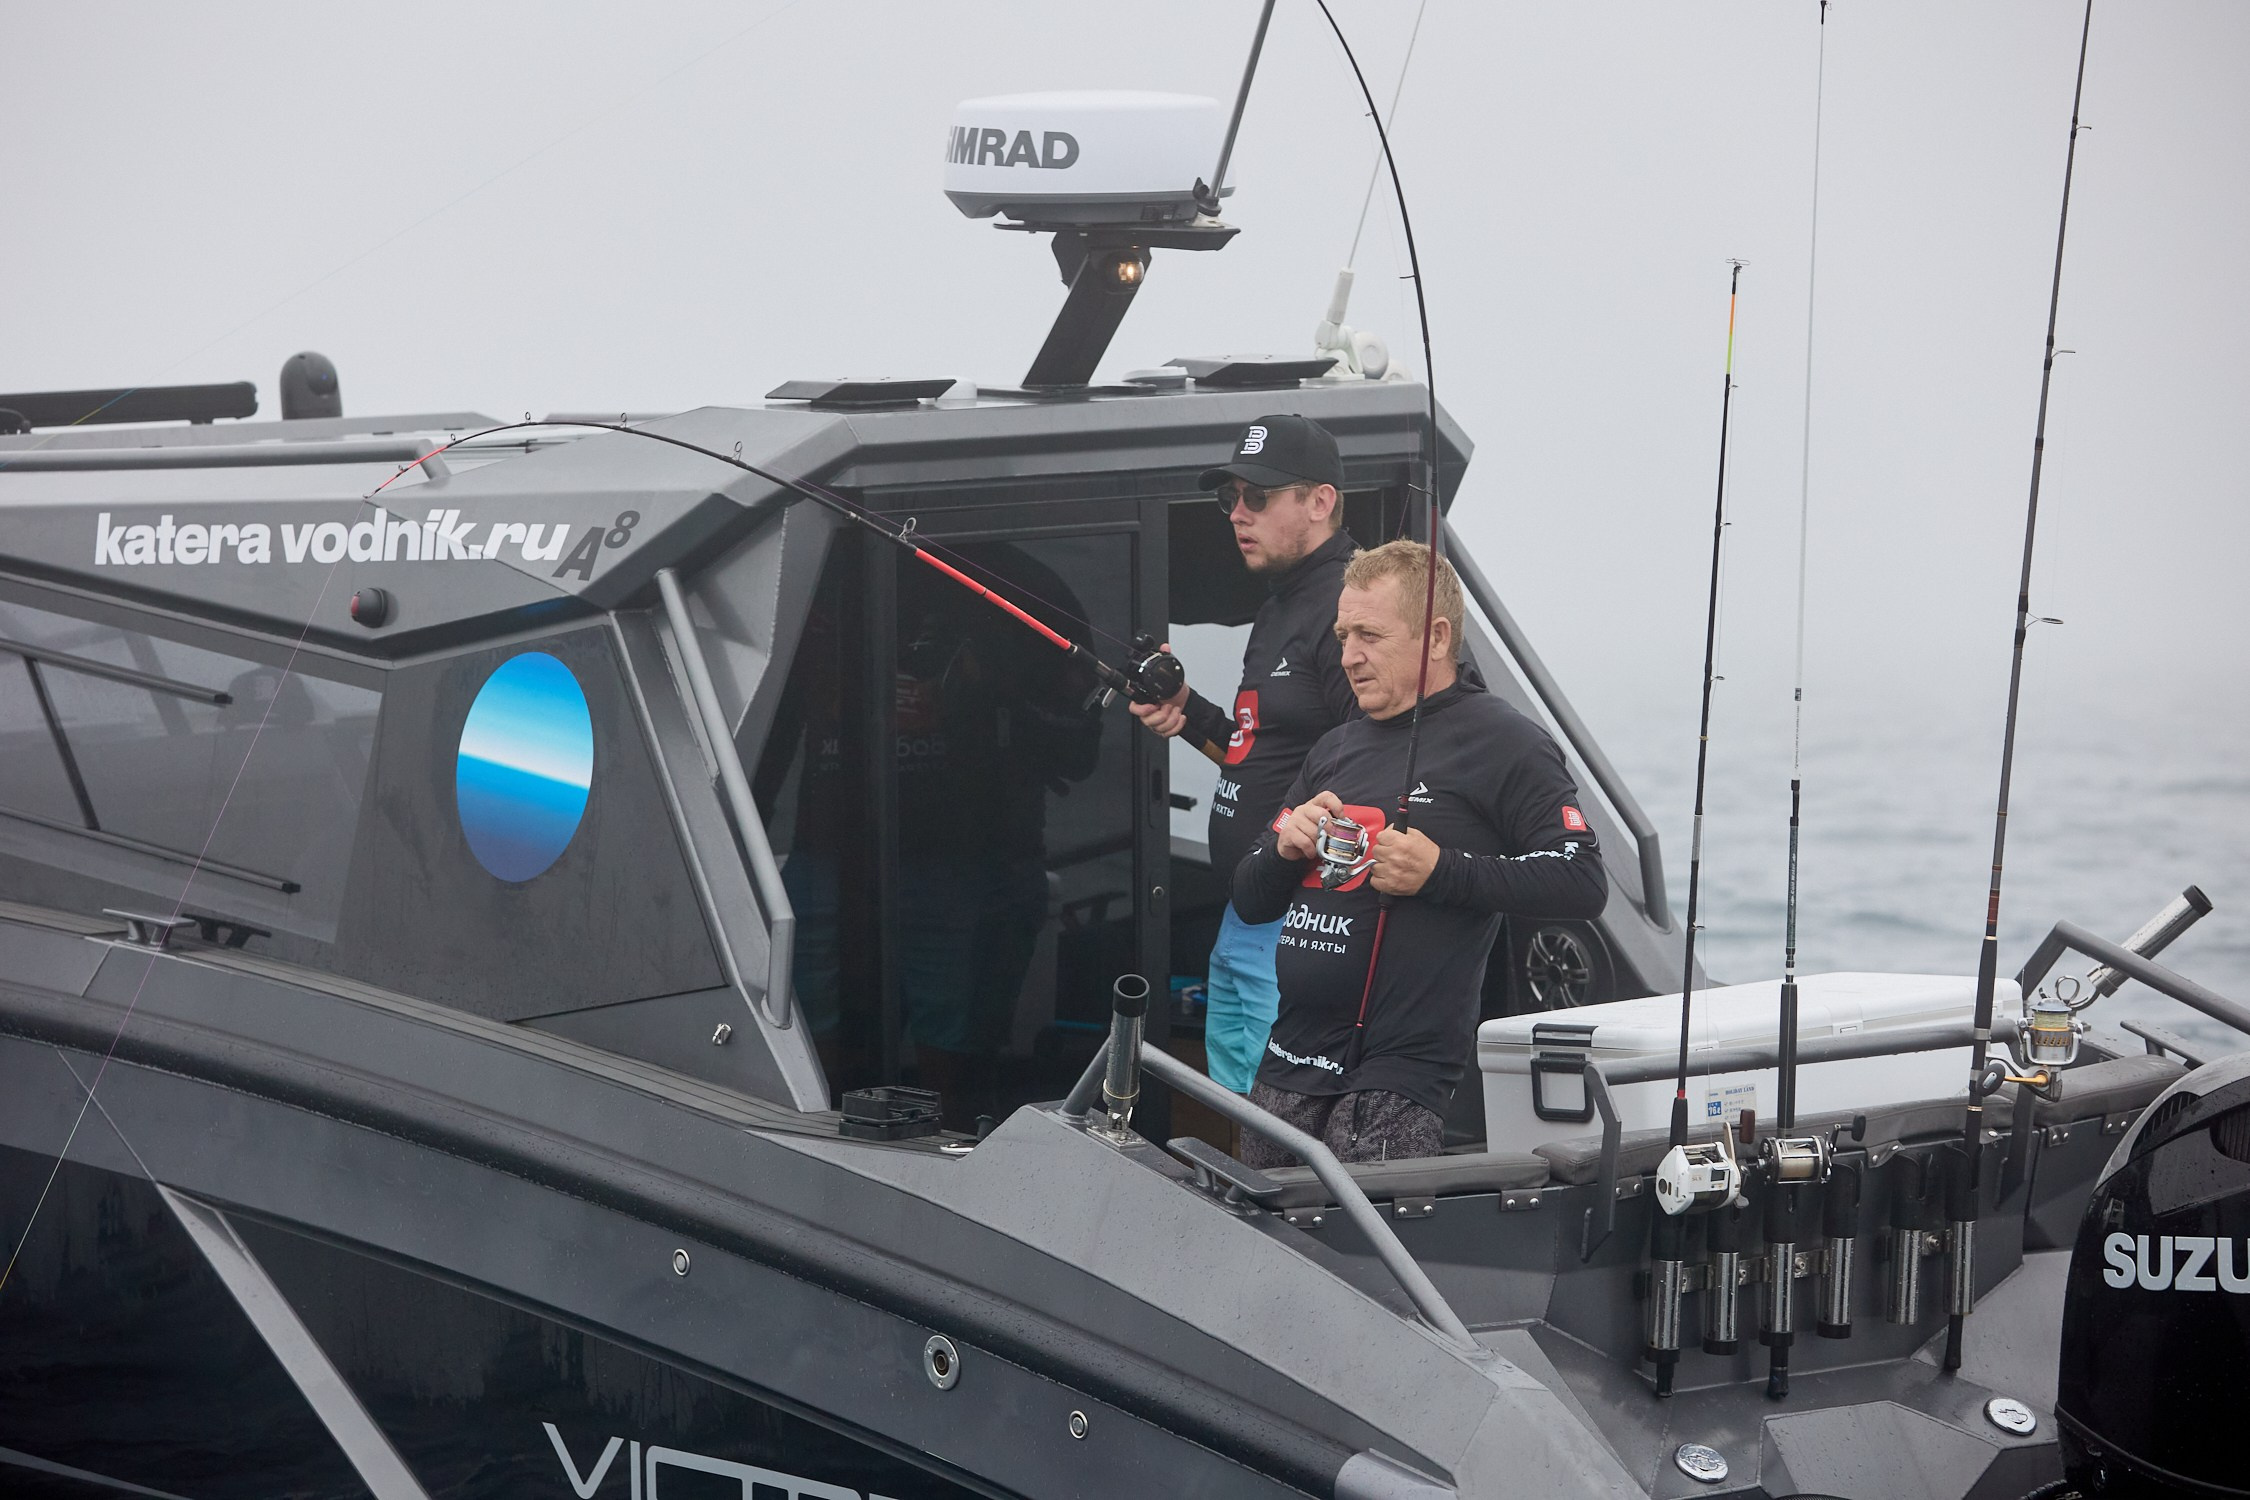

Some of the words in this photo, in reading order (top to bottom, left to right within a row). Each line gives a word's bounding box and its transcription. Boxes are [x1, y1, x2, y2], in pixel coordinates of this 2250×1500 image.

[945, 125, 1080, 169] IMRAD
[94, 512, 272, 566] katera
[280, 507, 571, 564] vodnik.ru
[1299, 938, 1308, 949] И
[1310, 940, 1347, 954] ЯХТЫ
